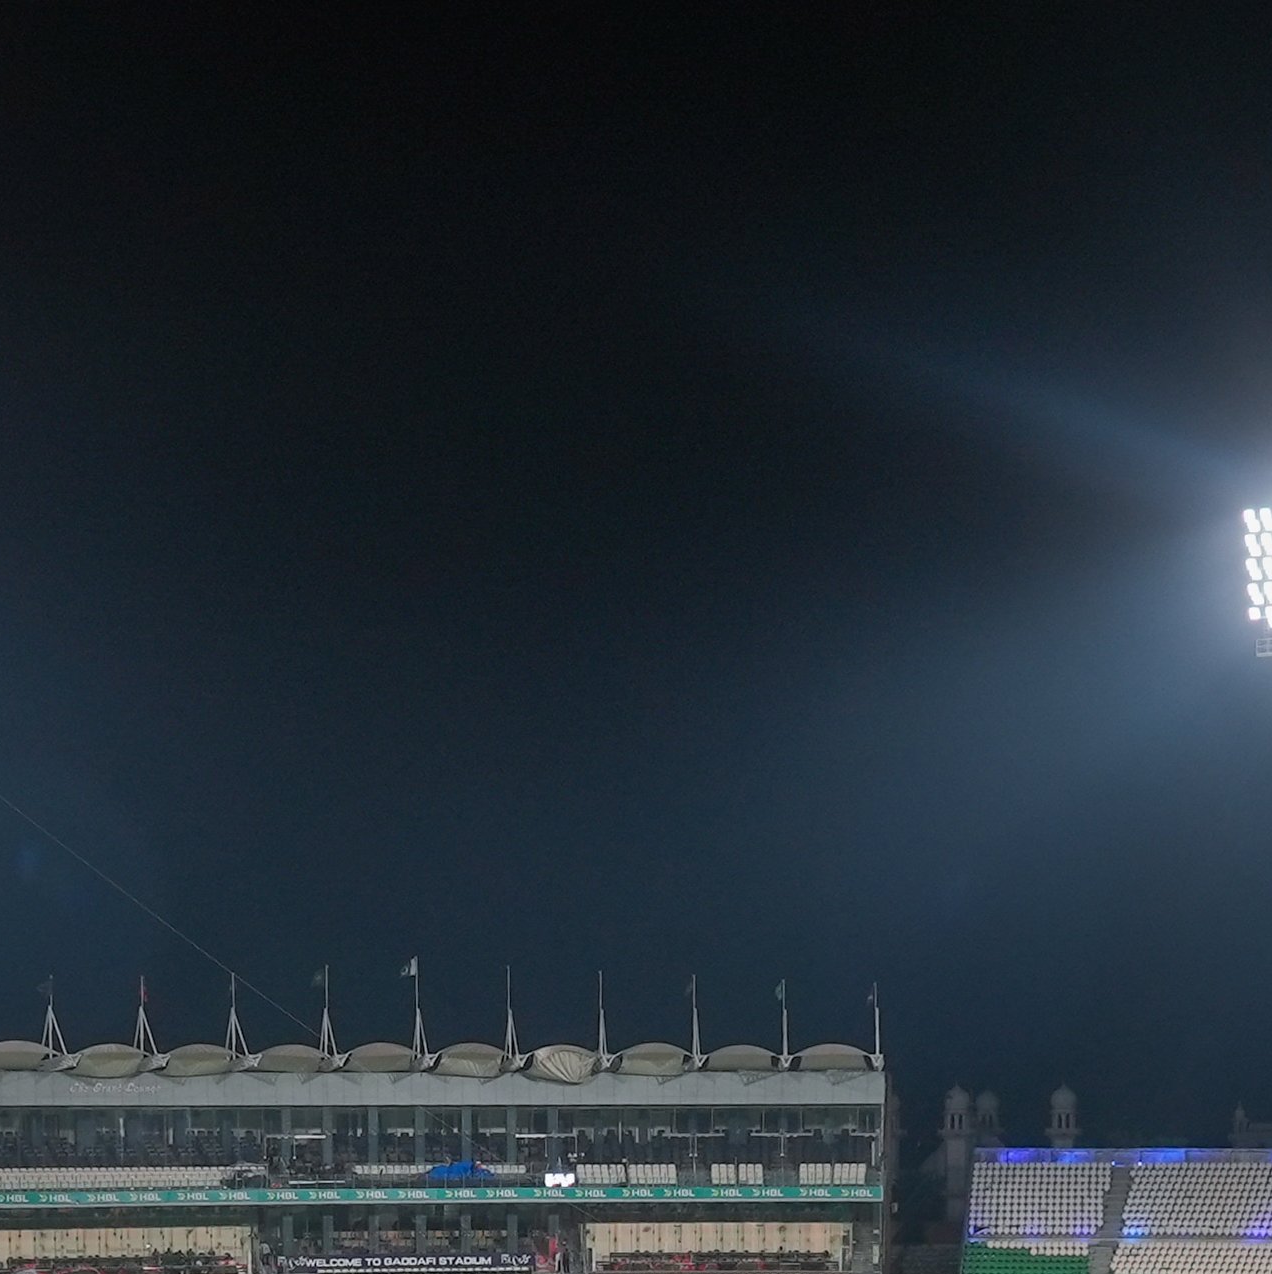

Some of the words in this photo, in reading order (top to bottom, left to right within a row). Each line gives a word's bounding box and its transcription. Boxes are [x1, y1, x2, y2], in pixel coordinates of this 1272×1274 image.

[6, 1194, 29, 1202] HBL
[49, 1194, 72, 1202] HBL
[97, 1194, 119, 1202] HBL
[139, 1193, 162, 1201] HBL
[187, 1192, 209, 1201] HBL
[229, 1191, 251, 1200] HBL
[276, 1191, 299, 1200] HBL
[318, 1191, 341, 1200] HBL
[366, 1190, 388, 1199] HBL
[407, 1190, 429, 1199] HBL
[454, 1189, 477, 1198] HBL
[496, 1189, 518, 1198] HBL
[543, 1189, 565, 1198] HBL
[584, 1188, 606, 1197] HBL
[631, 1188, 653, 1197] HBL
[673, 1188, 695, 1197] HBL
[720, 1188, 743, 1197] HBL
[761, 1188, 783, 1197] HBL
[809, 1188, 831, 1197] HBL
[851, 1188, 873, 1197] HBL
[305, 1258, 362, 1267] WELCOME
[365, 1257, 381, 1266] TO
[383, 1257, 436, 1266] GADDAFI
[438, 1256, 492, 1266] STADIUM
